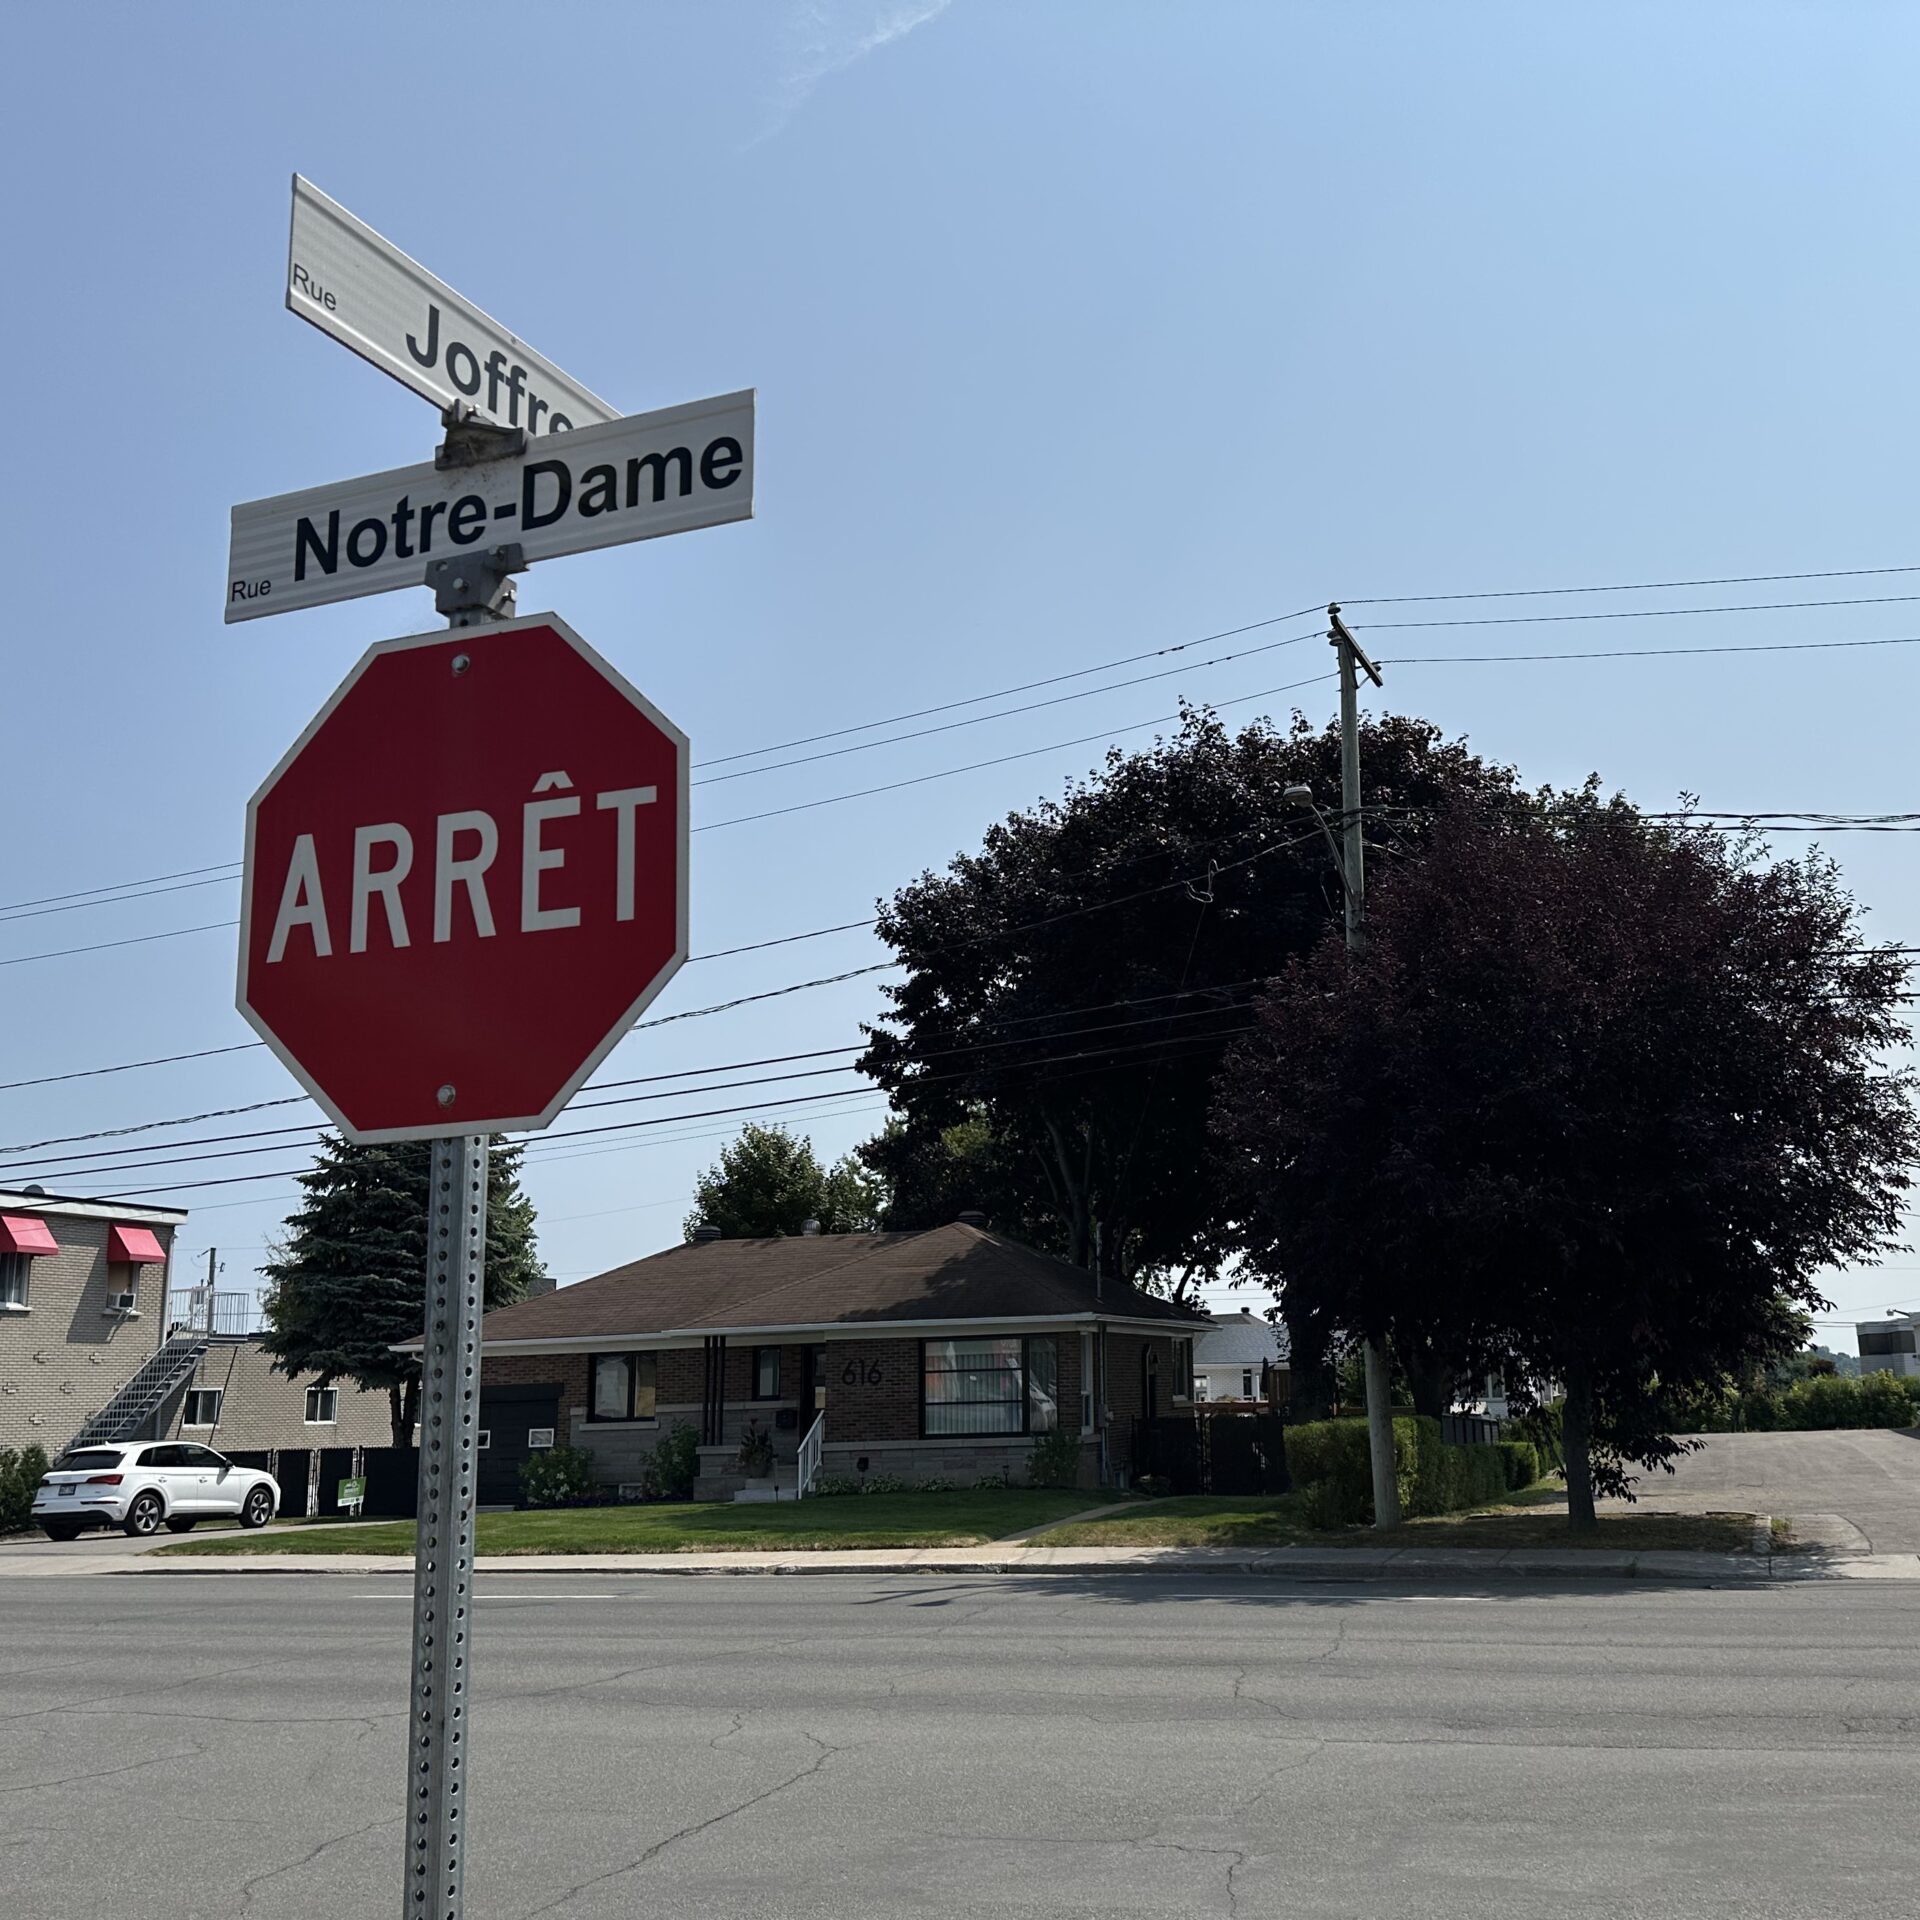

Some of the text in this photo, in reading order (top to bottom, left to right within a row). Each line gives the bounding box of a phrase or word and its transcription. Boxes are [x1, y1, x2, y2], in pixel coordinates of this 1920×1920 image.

[293, 263, 336, 311] Rue
[231, 435, 744, 602] Rue Notre-Dame
[266, 770, 658, 964] ARRÊT
[842, 1359, 882, 1387] 616
